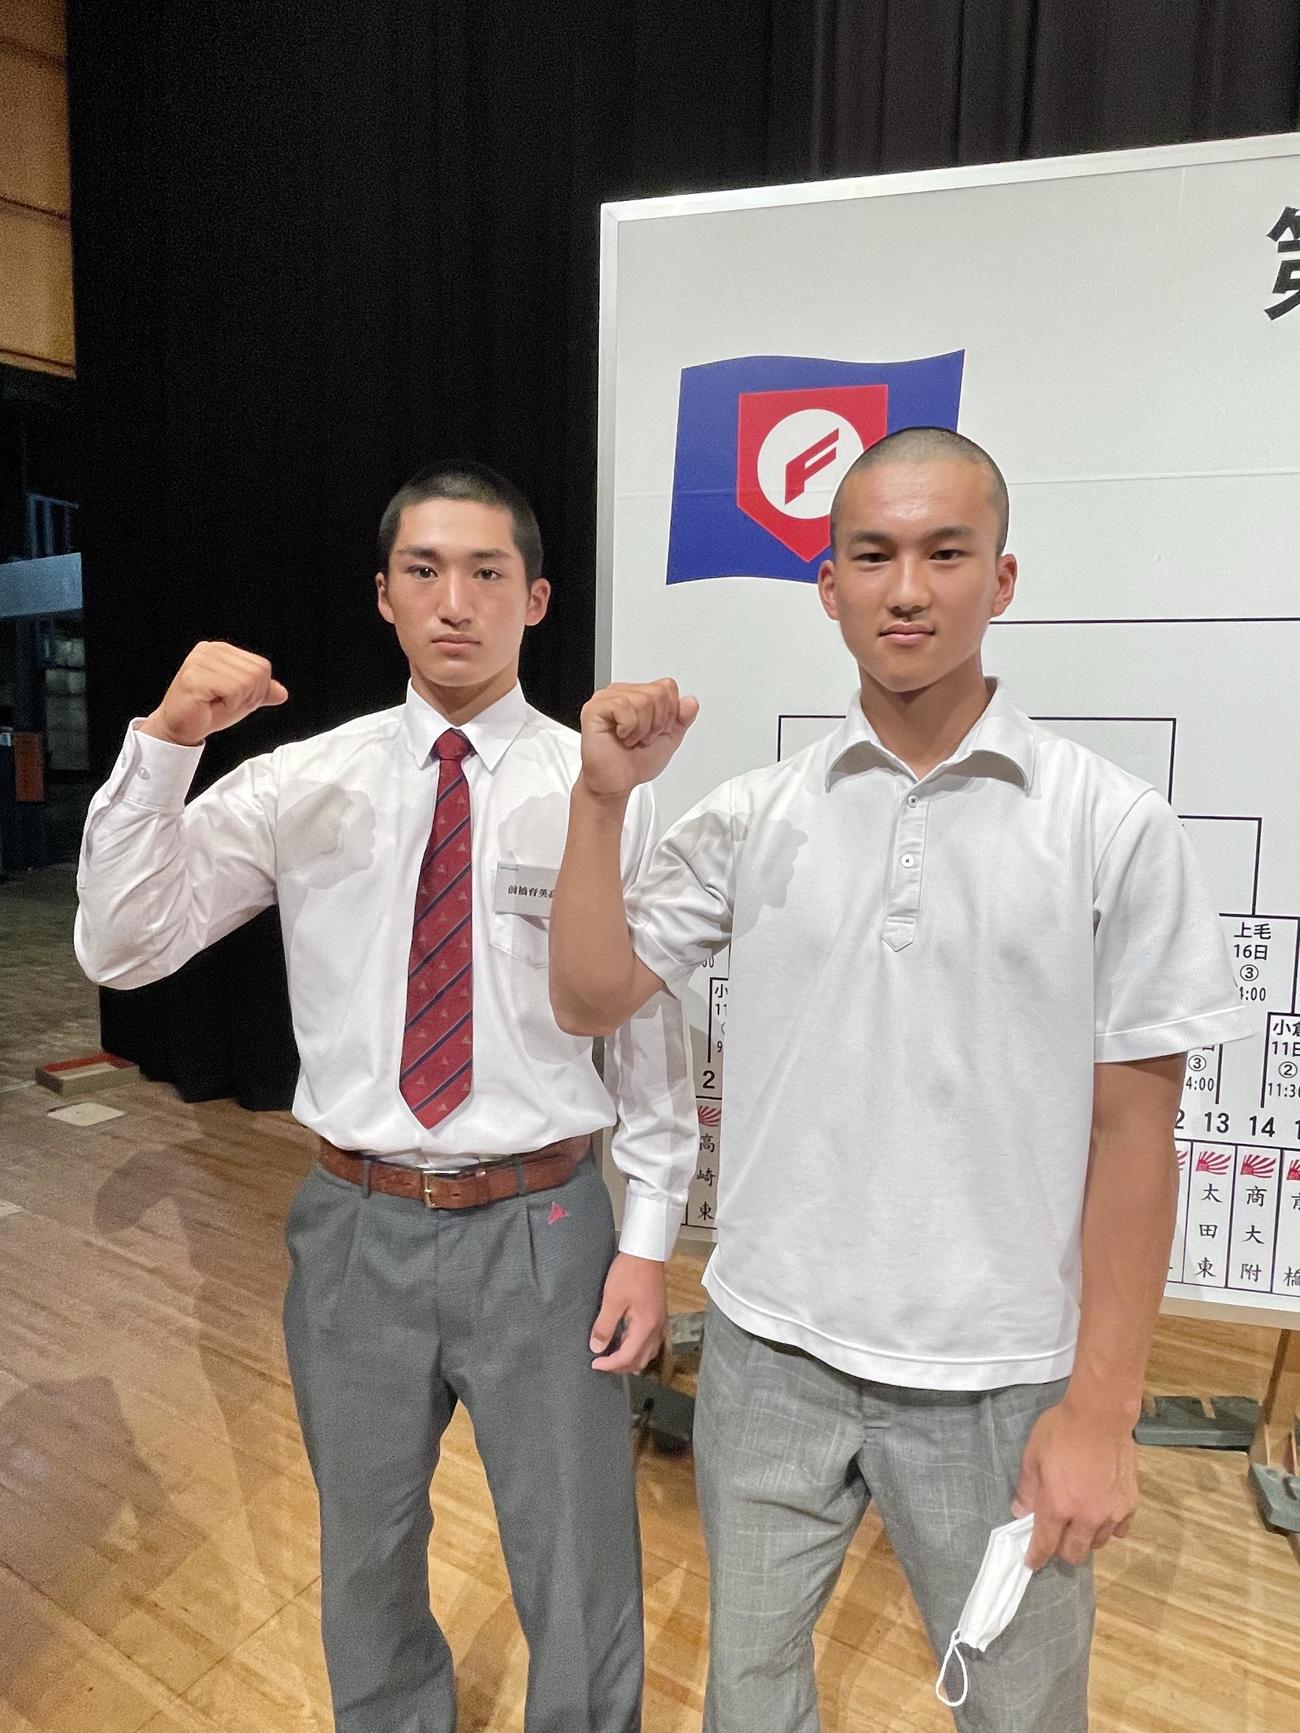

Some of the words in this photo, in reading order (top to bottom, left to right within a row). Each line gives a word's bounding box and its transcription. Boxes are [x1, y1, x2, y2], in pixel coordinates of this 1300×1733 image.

[1233, 921, 1271, 940] 上毛
[1233, 943, 1268, 960] 16日
[702, 1070, 716, 1089] 2
[1185, 1076, 1214, 1092] 4:00
[1268, 1083, 1300, 1098] 11:3
[1174, 1108, 1185, 1130] 2
[1204, 1112, 1229, 1133] 13
[1249, 1115, 1275, 1137] 14
[1195, 1183, 1223, 1278] 太田東
